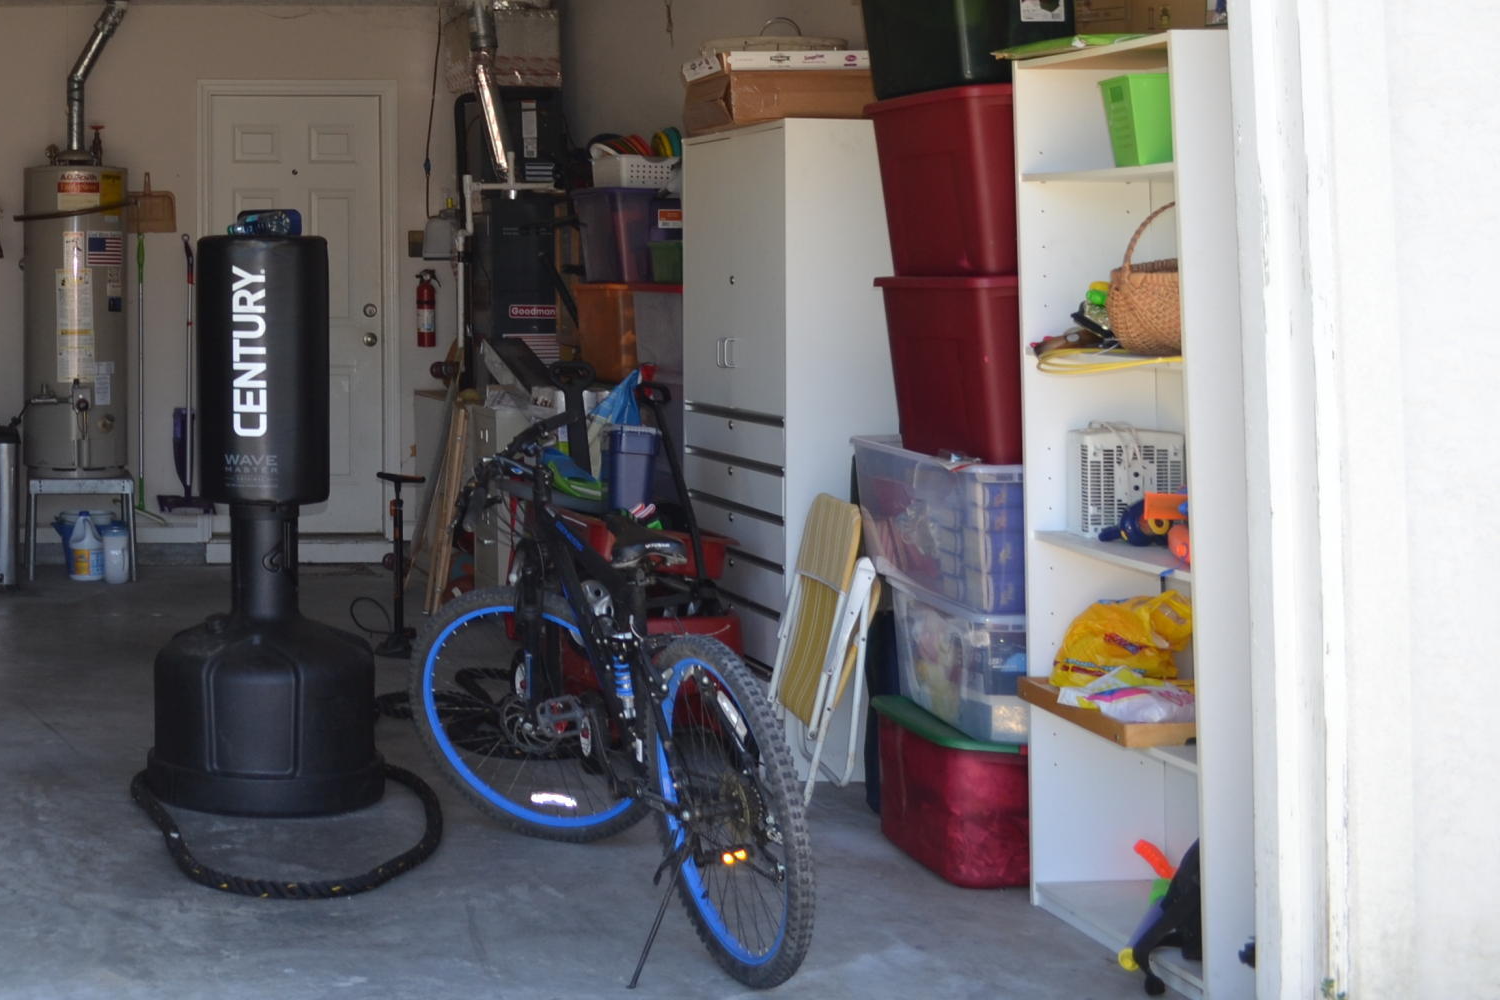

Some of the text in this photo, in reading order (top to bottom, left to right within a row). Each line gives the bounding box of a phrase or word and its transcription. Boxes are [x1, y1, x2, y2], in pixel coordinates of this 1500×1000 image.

[511, 307, 556, 316] Goodman
[232, 264, 267, 437] CENTURY
[224, 454, 277, 466] WAVE
